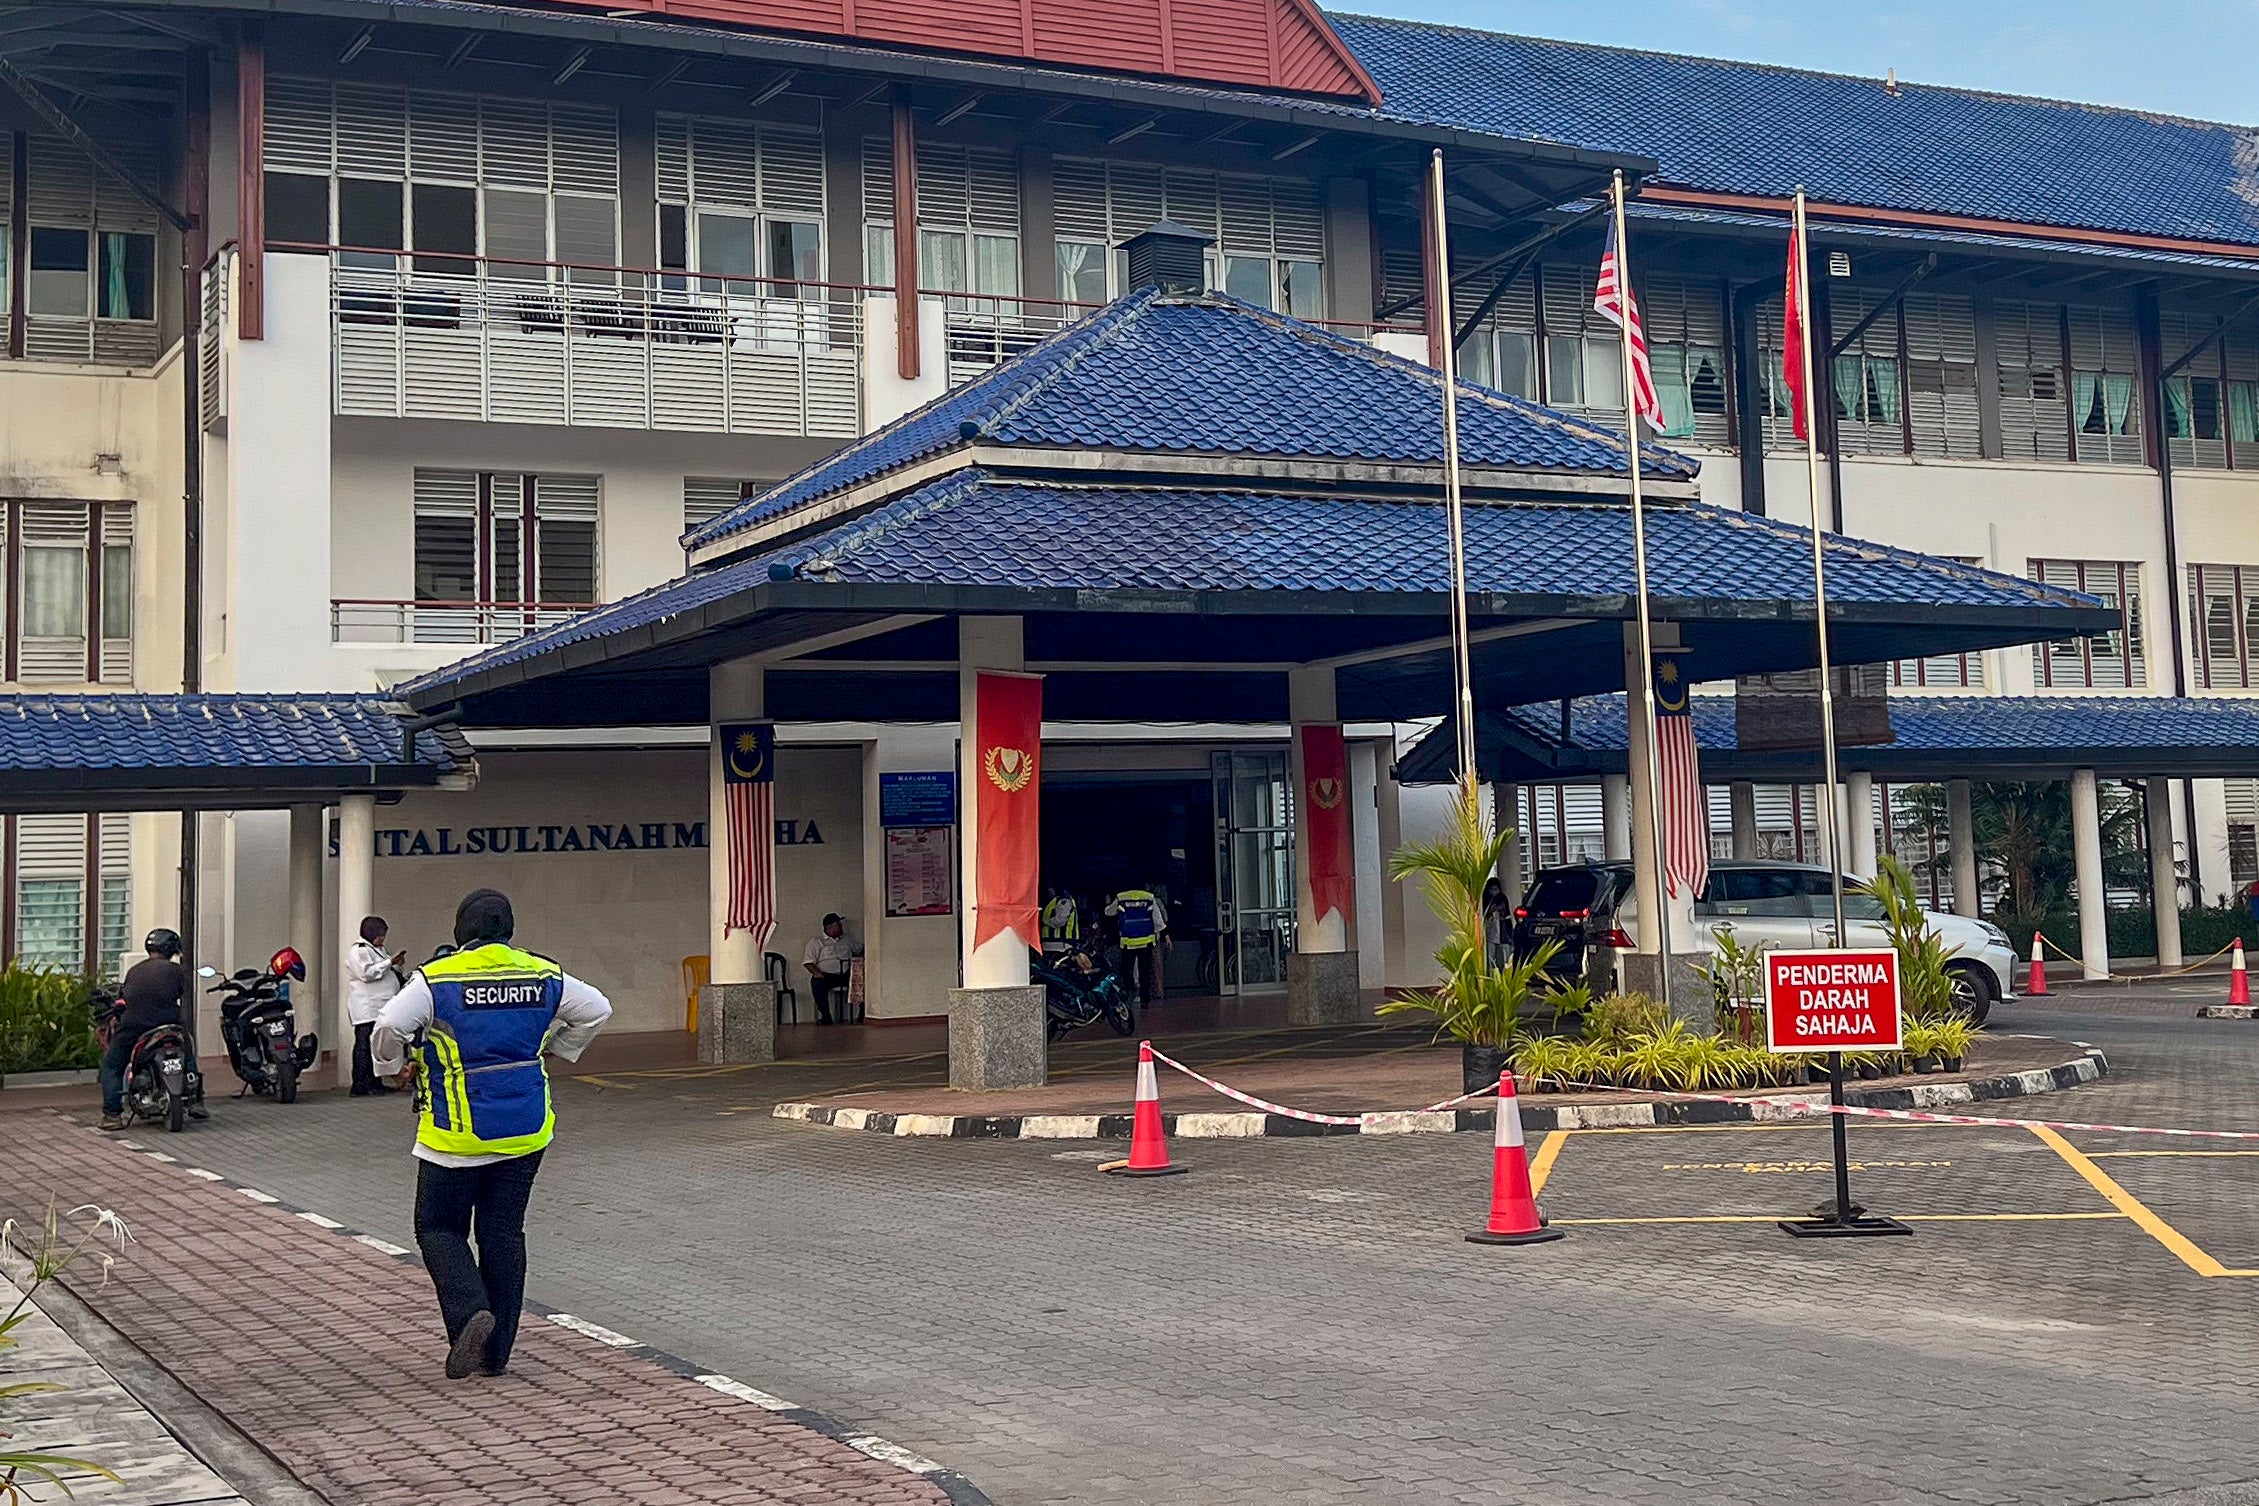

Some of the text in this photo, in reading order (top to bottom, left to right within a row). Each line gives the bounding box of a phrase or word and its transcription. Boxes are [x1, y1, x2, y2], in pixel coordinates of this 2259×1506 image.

[466, 823, 667, 853] SULTANAH
[672, 819, 824, 849] MHA
[1777, 964, 1888, 986] PENDERMA
[465, 985, 543, 1005] SECURITY
[1799, 988, 1869, 1010] DARAH
[1795, 1014, 1876, 1036] SAHAJA
